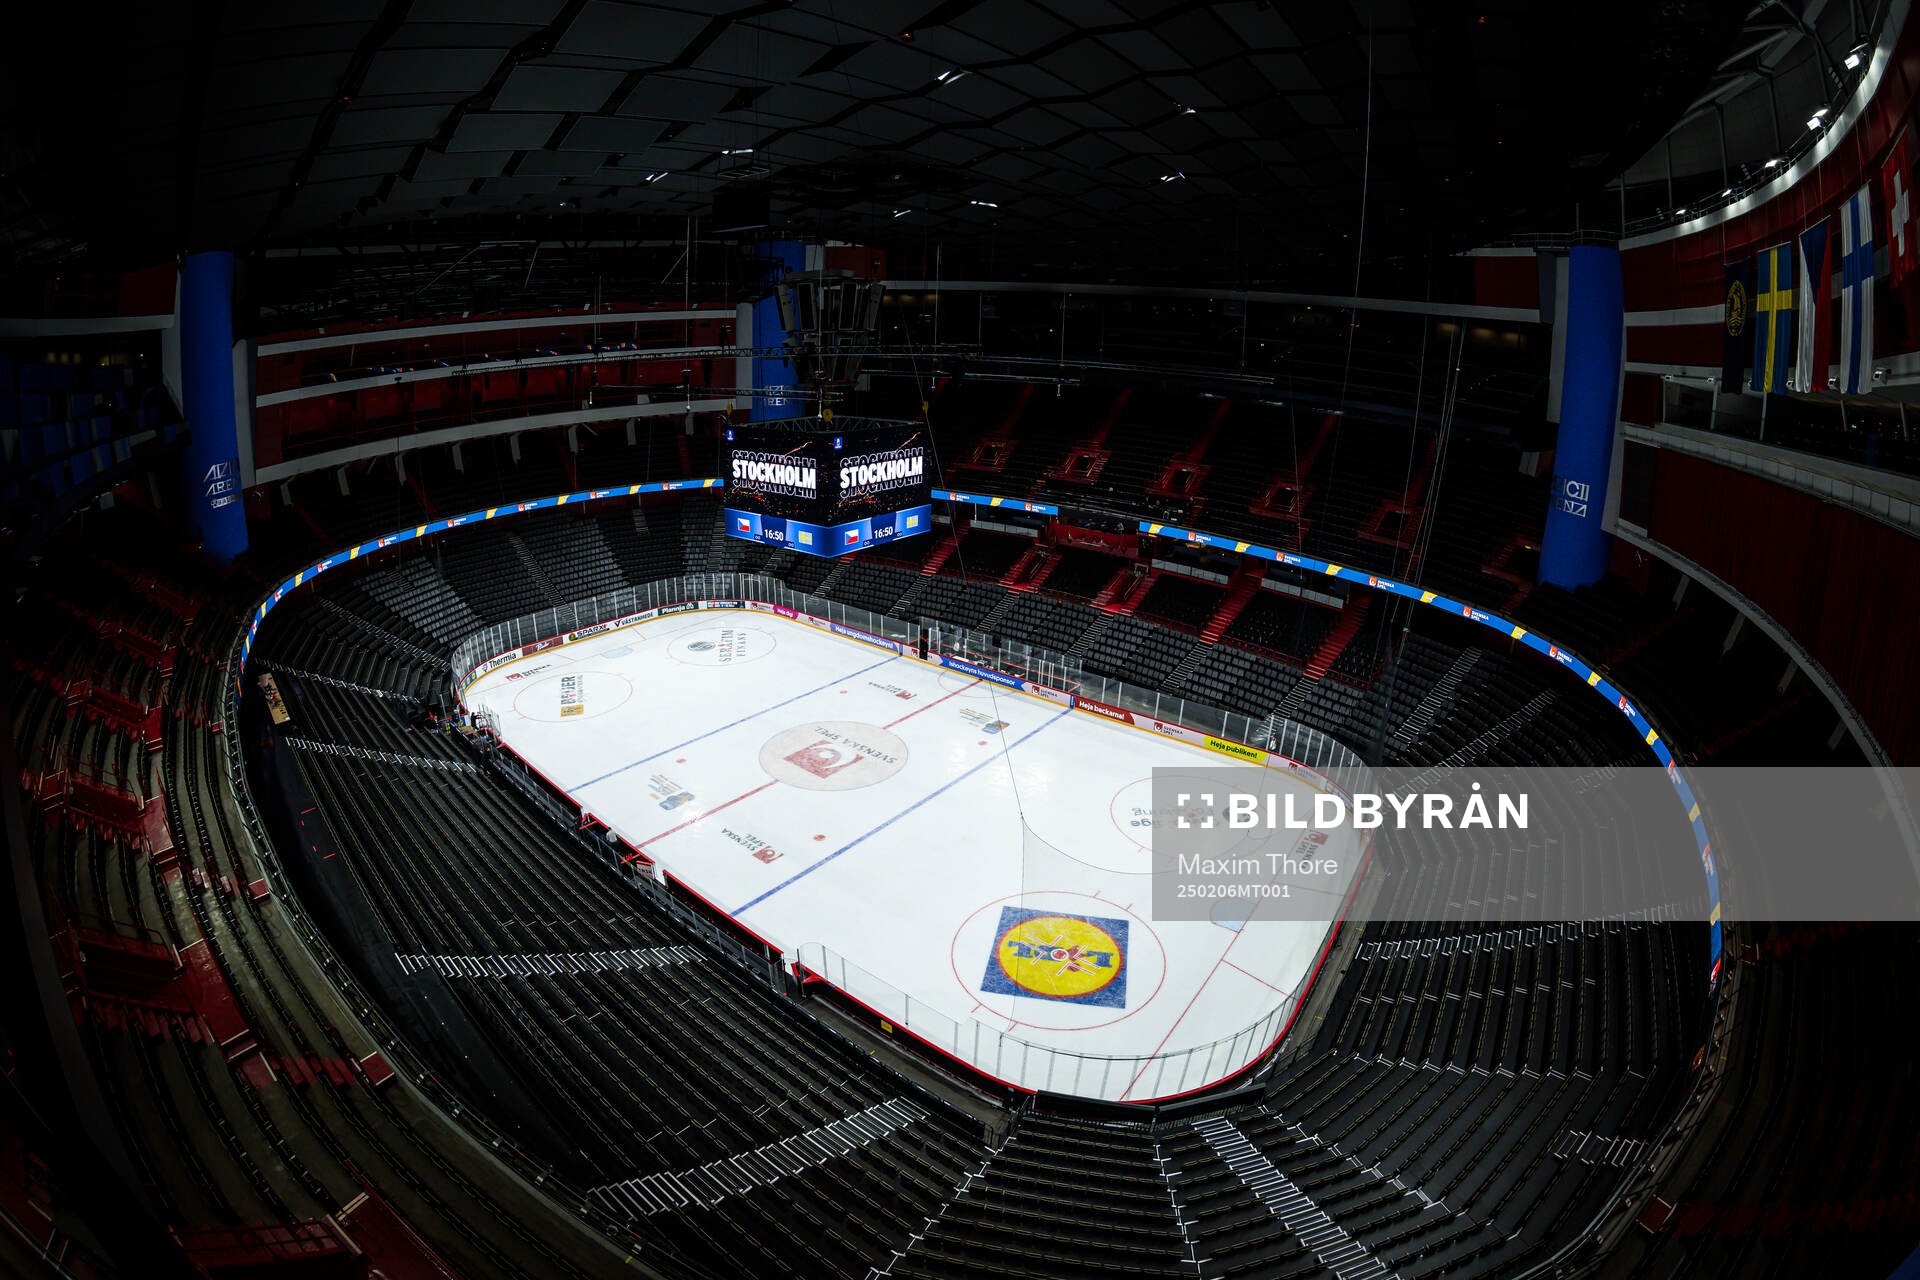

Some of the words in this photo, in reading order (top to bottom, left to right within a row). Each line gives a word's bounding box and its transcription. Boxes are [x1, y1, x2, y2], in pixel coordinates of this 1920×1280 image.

[732, 458, 817, 490] STOCKHOLM
[839, 456, 923, 490] STOCKHOLM
[764, 529, 784, 541] 16:50
[874, 526, 893, 539] 16:50
[661, 605, 686, 615] Plannja
[576, 624, 604, 638] SPARX
[489, 652, 517, 669] Thermia
[1079, 700, 1094, 711] Heja
[815, 726, 842, 741] SPEL
[842, 738, 898, 764] SVENSKA
[1210, 739, 1226, 750] Heja
[1225, 745, 1258, 759] publiken!
[721, 827, 756, 852] SVENSKA
